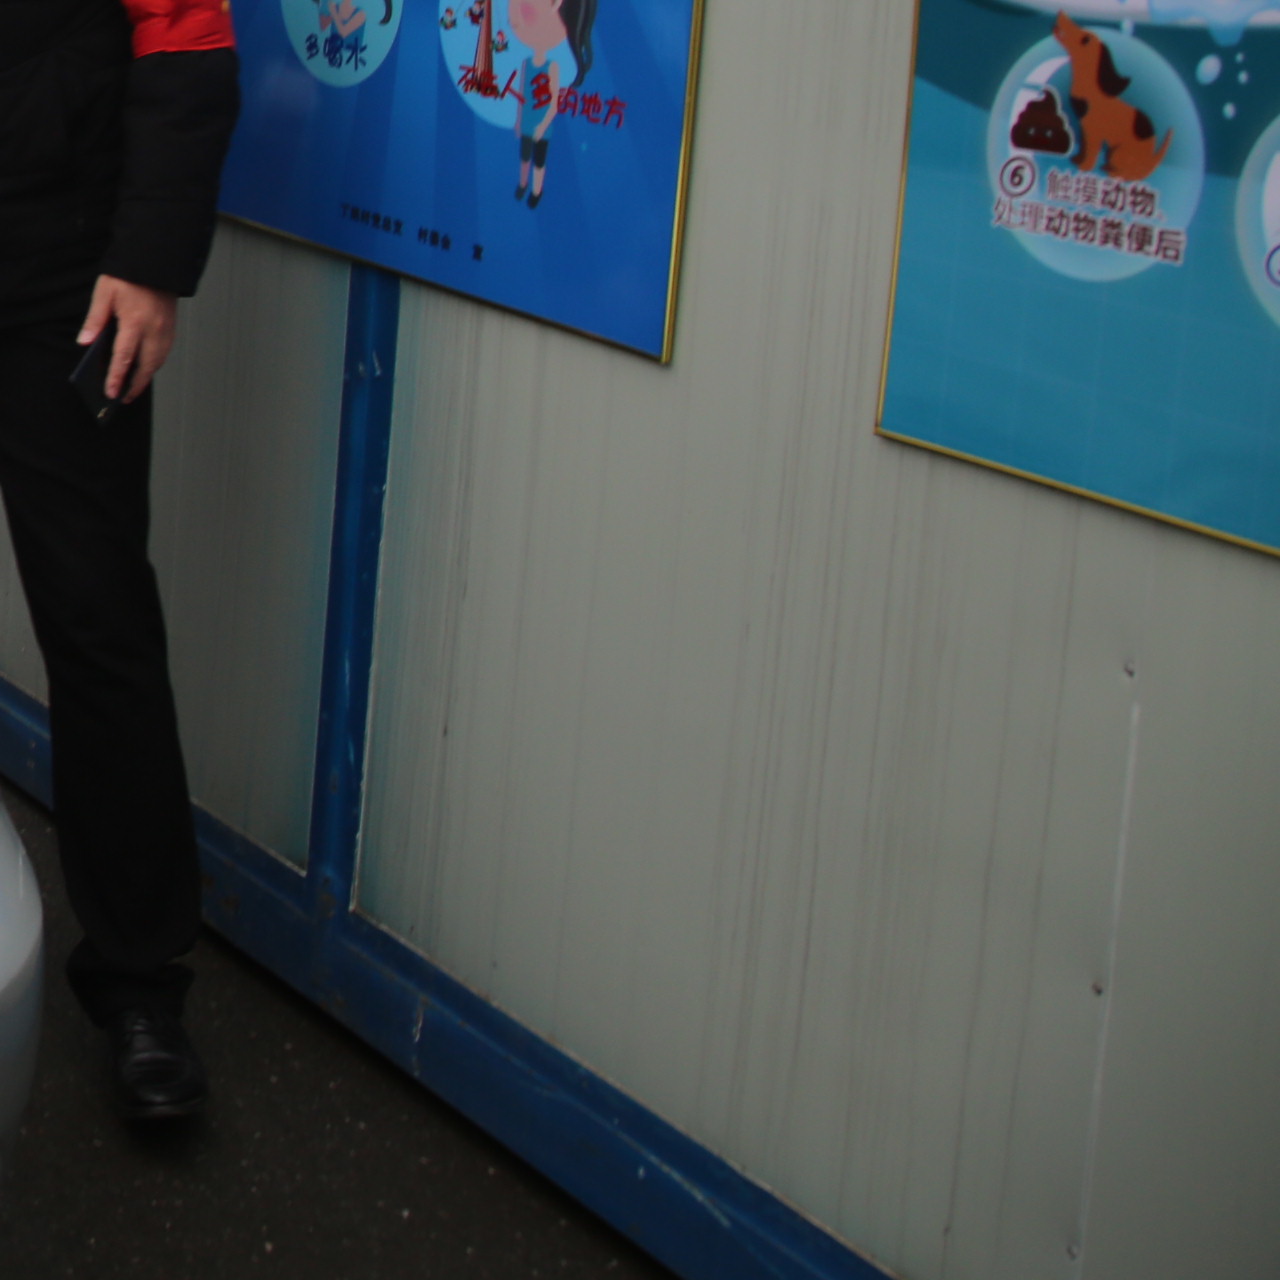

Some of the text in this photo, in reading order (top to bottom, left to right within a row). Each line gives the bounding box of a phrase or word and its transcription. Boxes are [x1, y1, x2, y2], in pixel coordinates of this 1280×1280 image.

[305, 35, 368, 71] 多喝水
[994, 198, 1185, 264] 处理动物粪便后
